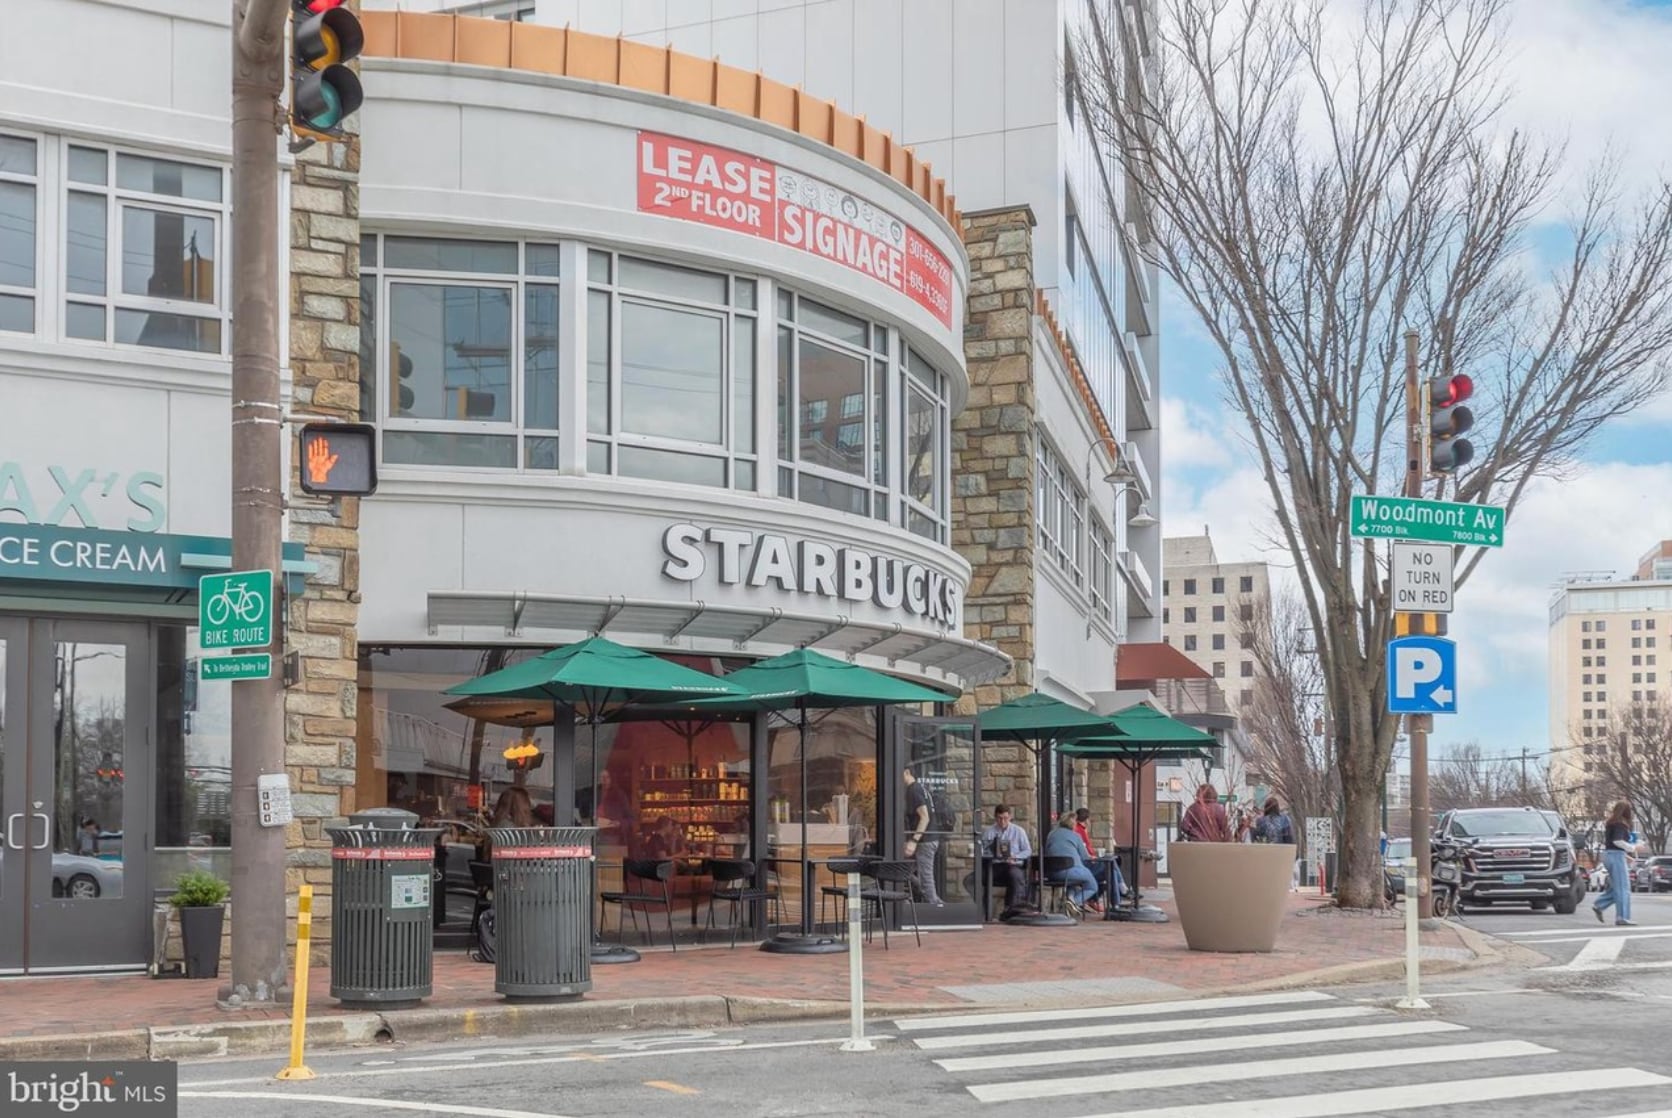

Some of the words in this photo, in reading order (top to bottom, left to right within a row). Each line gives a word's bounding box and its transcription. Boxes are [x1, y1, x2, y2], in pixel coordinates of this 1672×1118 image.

[642, 141, 772, 202] LEASE
[654, 181, 690, 207] 2ND
[690, 190, 761, 227] FLOOR
[783, 204, 902, 289] SIGNAGE
[1361, 499, 1466, 527] Woodmont
[1473, 508, 1497, 529] Av
[1371, 524, 1393, 534] 7700
[1452, 531, 1472, 540] 7800
[50, 540, 167, 573] CREAM
[1412, 552, 1433, 565] NO
[662, 522, 958, 629] STARBUCKS
[1406, 571, 1441, 584] TURN
[1399, 590, 1416, 603] ON
[1423, 590, 1448, 604] RED
[206, 630, 228, 645] BIKE
[233, 627, 264, 642] ROUTE
[1395, 647, 1443, 699] P
